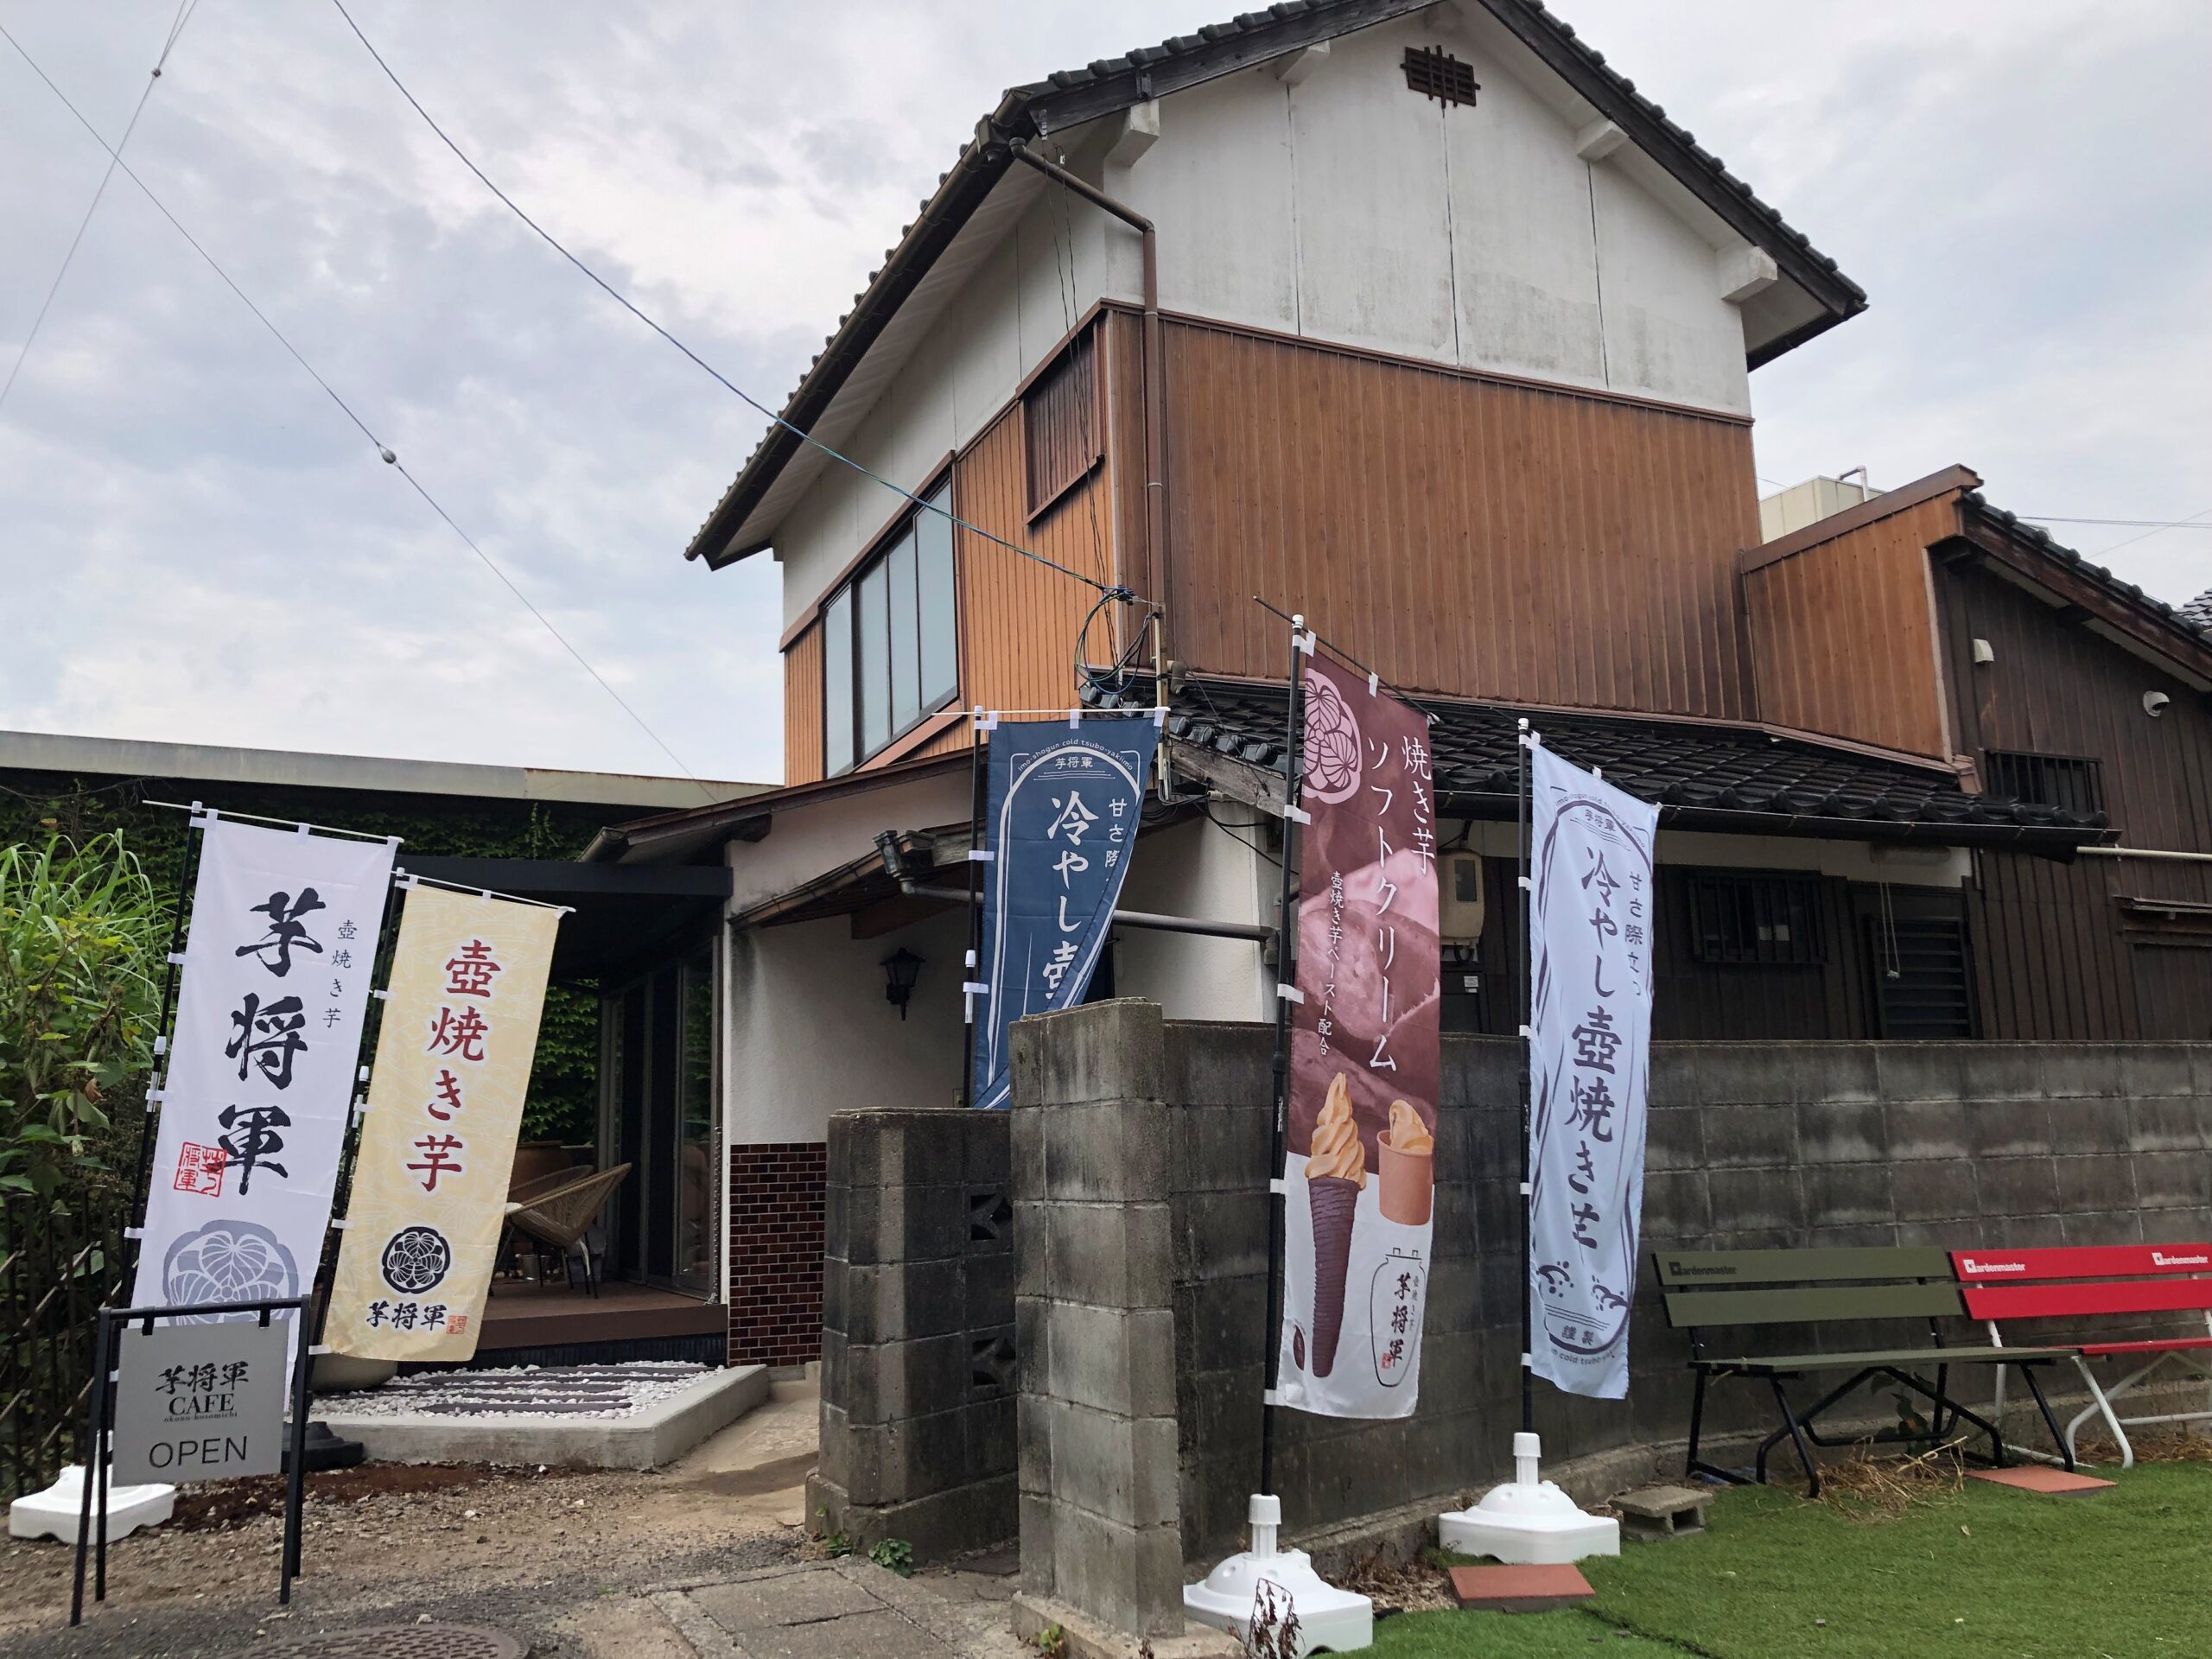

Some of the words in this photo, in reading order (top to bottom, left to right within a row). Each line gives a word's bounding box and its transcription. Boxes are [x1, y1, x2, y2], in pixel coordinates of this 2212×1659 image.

[1054, 755, 1094, 770] 芋将軍
[1062, 738, 1078, 747] cold
[1401, 735, 1435, 875] 焼き芋
[1368, 736, 1398, 1072] ソフトクリーム
[321, 919, 358, 1029] 壺焼き芋
[1318, 871, 1344, 1056] 壺焼き芋ペースト配合
[218, 887, 327, 1196] 芋将軍
[407, 939, 502, 1192] 壺焼き芋
[366, 1300, 448, 1332] 芋将軍
[1389, 1272, 1411, 1368] 芋将軍
[155, 1361, 249, 1395] 芋将軍
[1559, 1353, 1578, 1363] cold
[168, 1393, 234, 1415] CAFE
[149, 1435, 247, 1469] OPEN
